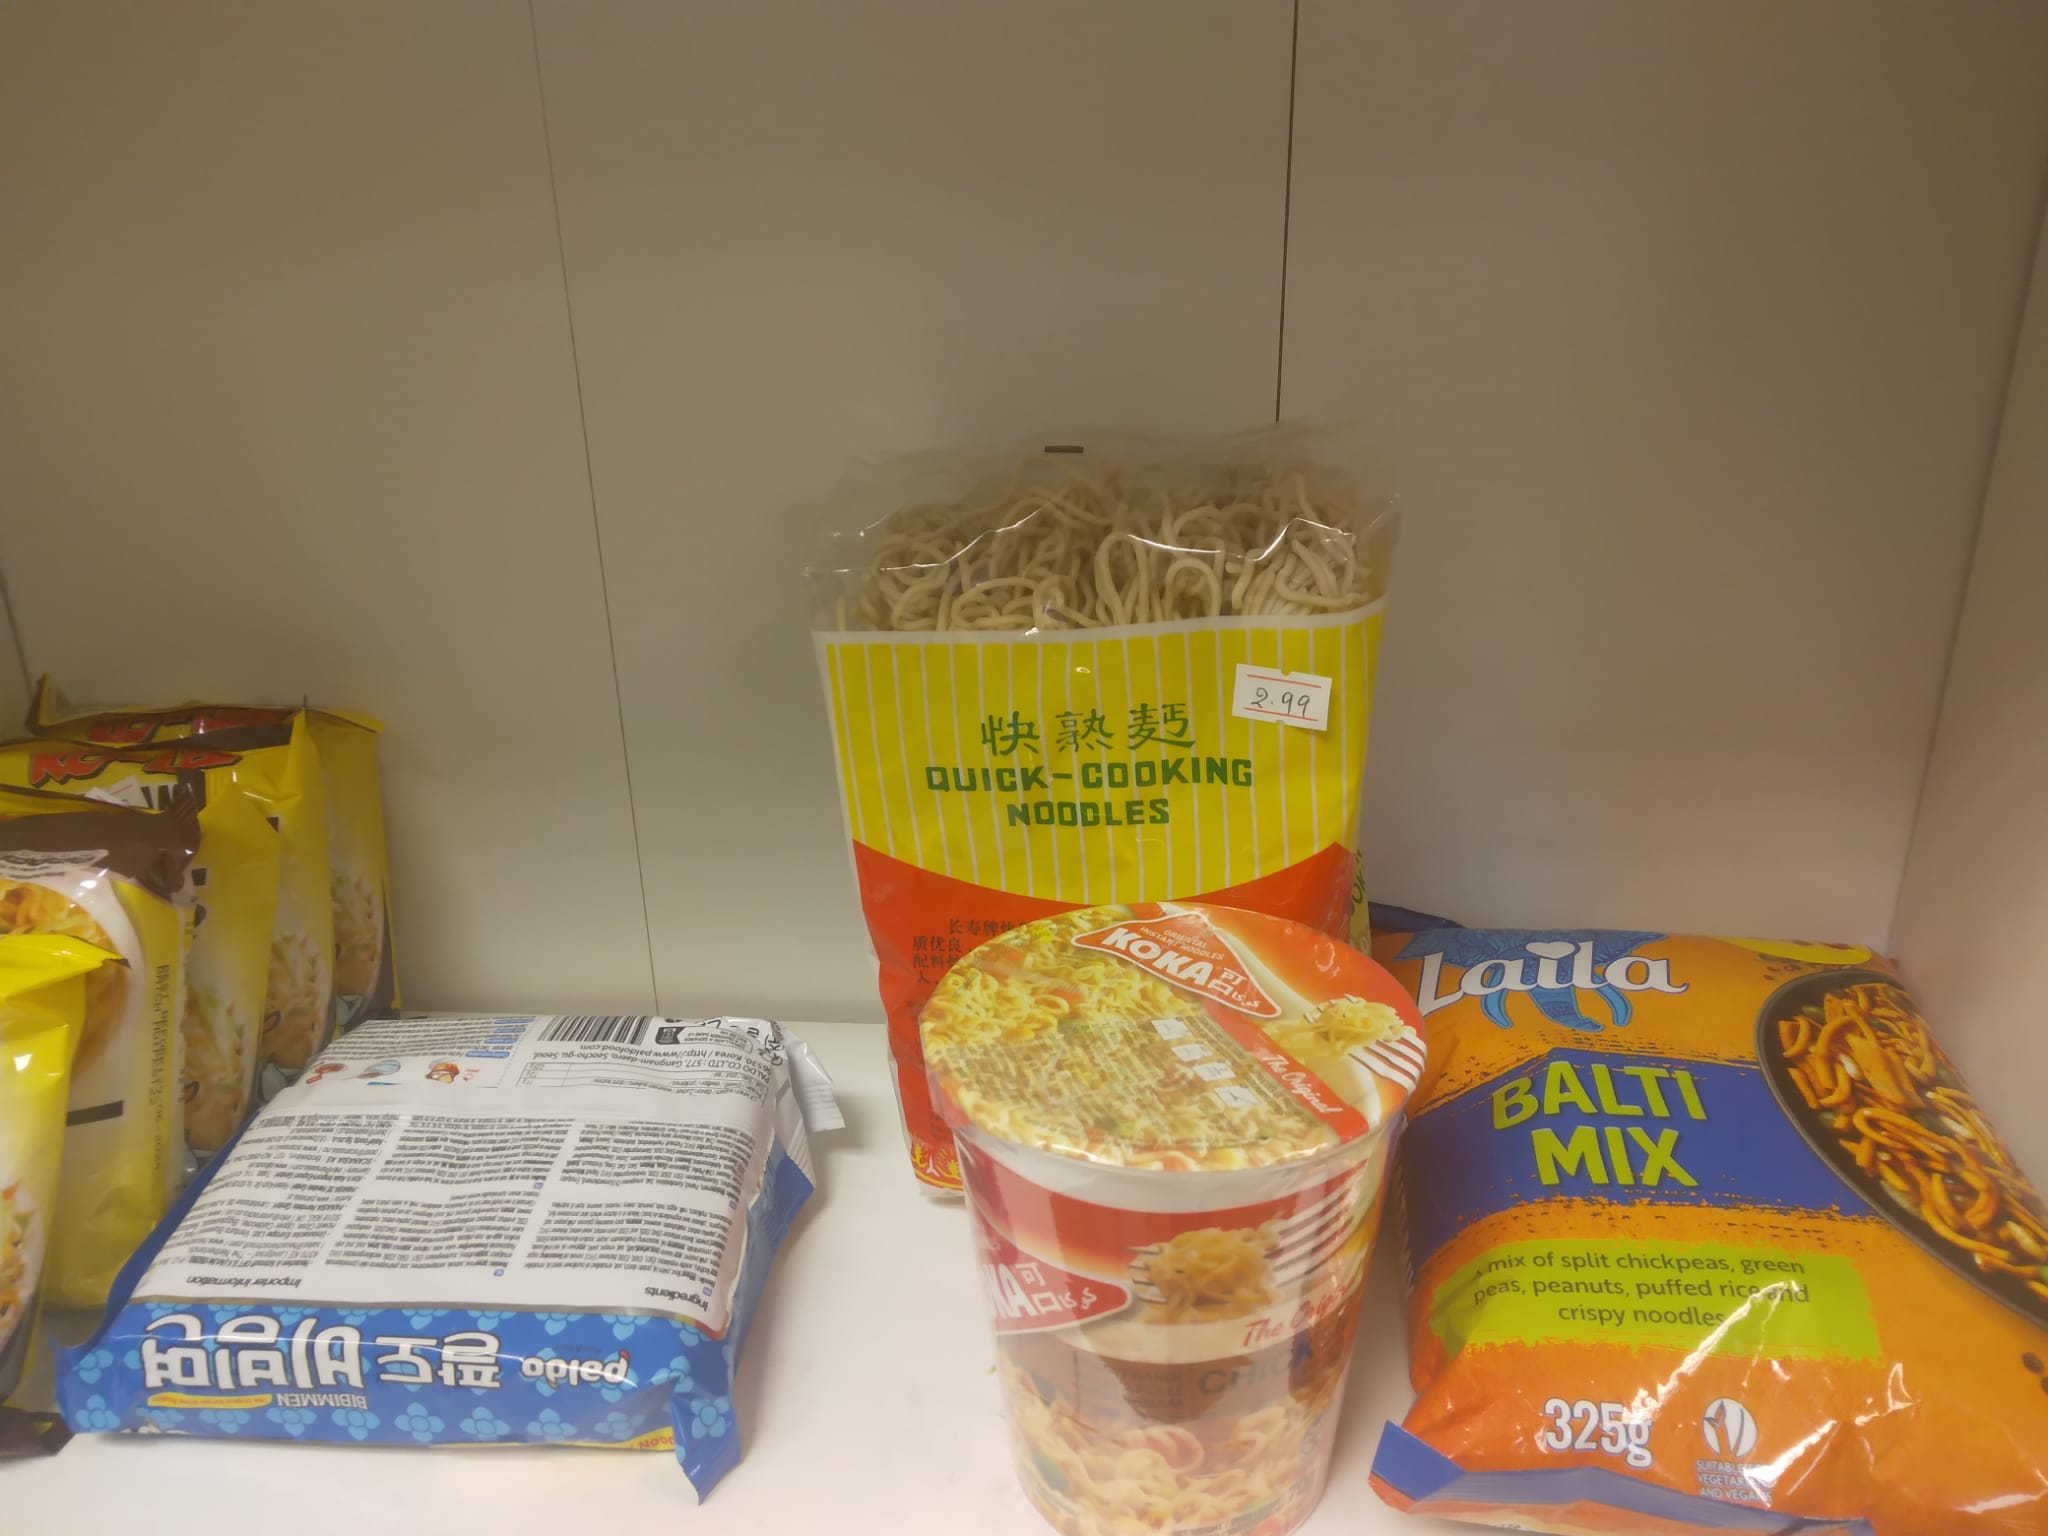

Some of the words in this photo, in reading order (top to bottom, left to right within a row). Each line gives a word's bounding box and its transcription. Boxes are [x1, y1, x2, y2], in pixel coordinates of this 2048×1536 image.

[1250, 687, 1311, 719] 2.99
[925, 757, 1253, 793] QUICK-COOKING
[1007, 798, 1170, 827] NOODLES
[1140, 926, 1180, 948] INSTANT
[1178, 943, 1225, 961] NOODLES
[1163, 929, 1209, 948] ORIENTAL
[1102, 927, 1214, 986] KOKA
[1416, 940, 1690, 1016] Laila
[714, 1050, 742, 1061] Korea
[742, 1065, 770, 1083] PALDO
[1262, 1054, 1287, 1074] The
[1281, 1072, 1343, 1114] Original
[1491, 1060, 1708, 1131] BALTI
[1530, 1125, 1700, 1187] MIX
[1488, 1254, 1526, 1273] mix
[1533, 1251, 1555, 1268] of
[1562, 1252, 1611, 1271] split
[1616, 1253, 1735, 1274] chickpeas,
[1740, 1259, 1806, 1276] green
[186, 1275, 251, 1288] Information
[252, 1276, 302, 1288] Importer
[1474, 1280, 1526, 1305] peas,
[1533, 1279, 1630, 1298] peanuts,
[1636, 1279, 1712, 1299] puffed
[1720, 1280, 1760, 1299] rice
[1767, 1282, 1810, 1303] and
[644, 1286, 709, 1312] Ingredients
[1558, 1304, 1625, 1326] crispy
[1243, 1318, 1285, 1347] The
[140, 1313, 365, 1390] 비빔면
[374, 1331, 501, 1389] 팔도
[520, 1348, 630, 1387] paldo
[275, 1392, 368, 1410] BIBIMMEN
[1544, 1397, 1653, 1468] 325g
[1697, 1474, 1774, 1488] VEGETAR
[1700, 1487, 1722, 1498] AND
